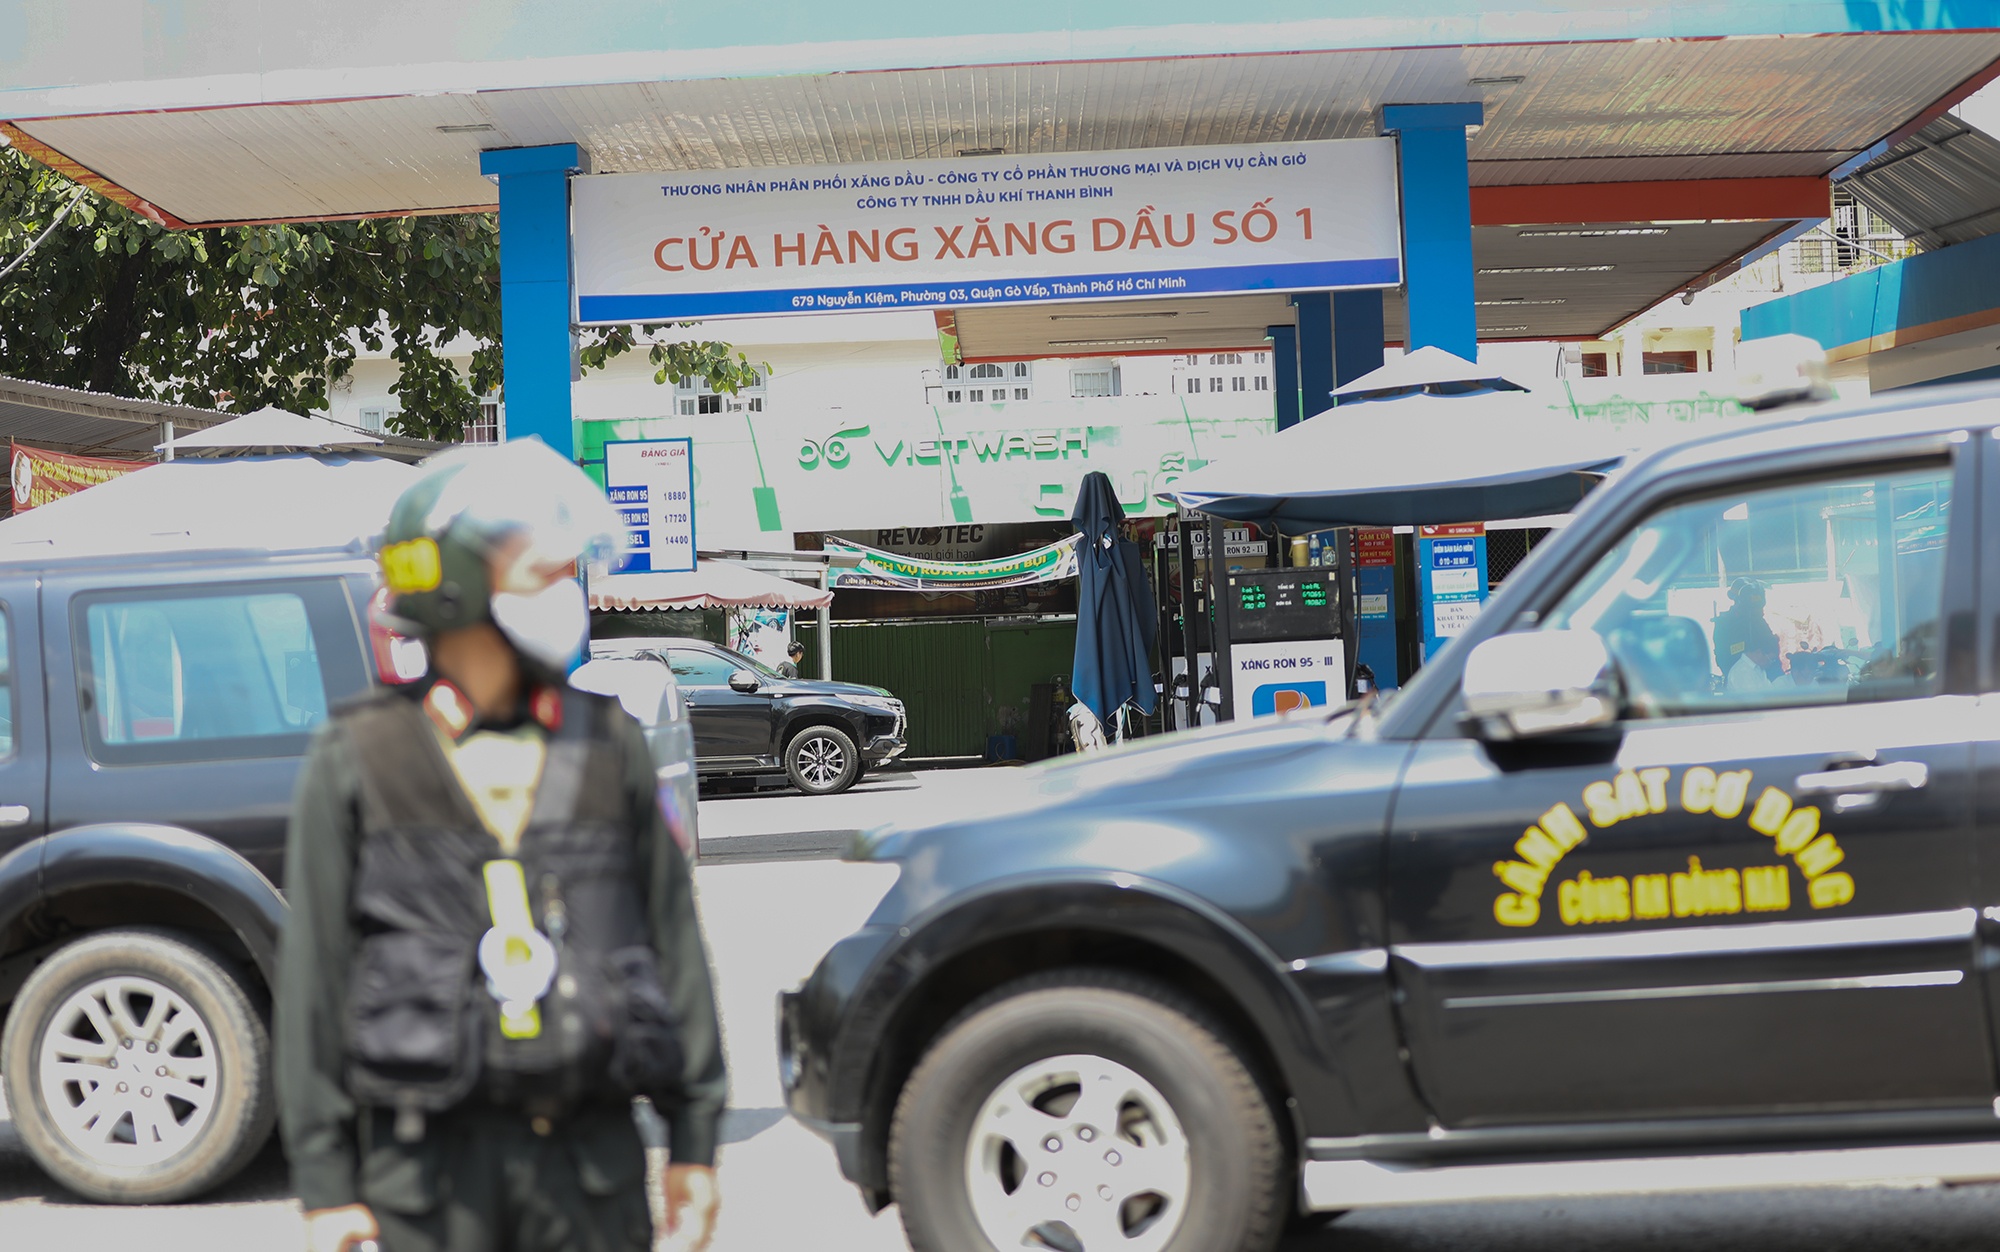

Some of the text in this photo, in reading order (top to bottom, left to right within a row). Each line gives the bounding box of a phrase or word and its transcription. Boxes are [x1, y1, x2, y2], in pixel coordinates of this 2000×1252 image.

[661, 184, 722, 196] THƯƠNG
[725, 180, 766, 194] NHÂN
[770, 178, 809, 192] PHÂN
[813, 173, 847, 190] PHỐI
[851, 174, 891, 189] XĂNG
[894, 170, 925, 186] DẦU
[937, 171, 978, 185] CÔNG
[981, 171, 999, 182] TY
[1003, 164, 1024, 181] CỔ
[1027, 163, 1067, 180] PHẦN
[1070, 164, 1131, 177] THƯƠNG
[1134, 162, 1161, 177] MẠI
[1164, 159, 1183, 172] VÀ
[1187, 158, 1221, 173] DỊCH
[1224, 157, 1244, 171] VỤ
[1247, 151, 1278, 168] CẦN
[1281, 152, 1307, 166] GIỜ
[856, 184, 1113, 209] CÔNG TY TNHH DẦU KHÍ THANH BÌNH
[653, 197, 1314, 272] CỬA HÀNG XĂNG DẦU SỐ 1
[791, 277, 1186, 307] 679 Nguyễn Kiệm, Phường 03, Quận Gò Vấp, Thành Phố Hồ Chí Minh
[670, 447, 686, 457] GIÁ
[626, 490, 639, 501] RON
[640, 490, 648, 500] 95
[664, 491, 687, 500] 18880
[664, 514, 687, 523] 17720
[665, 535, 689, 544] 14400
[936, 549, 954, 561] giới
[956, 549, 976, 560] hạn
[1226, 547, 1240, 555] RON
[1242, 546, 1250, 554] 92
[1273, 658, 1296, 669] RON
[1299, 657, 1313, 667] 95
[1324, 656, 1333, 666] III
